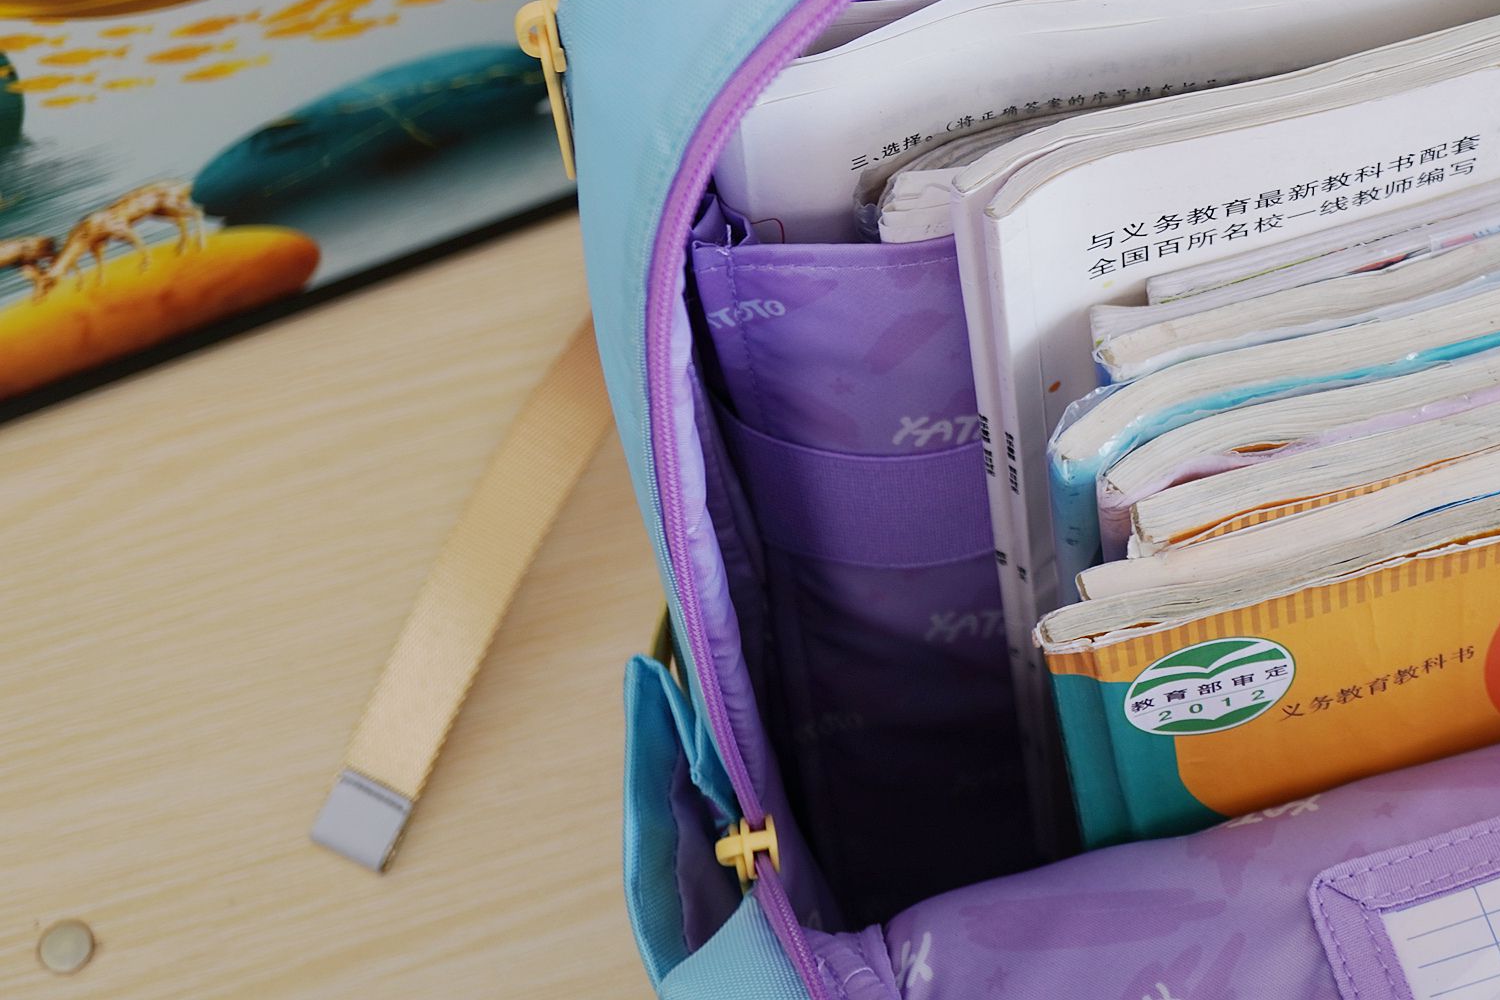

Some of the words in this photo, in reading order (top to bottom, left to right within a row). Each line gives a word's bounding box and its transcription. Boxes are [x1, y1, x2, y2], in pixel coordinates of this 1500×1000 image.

[1085, 133, 1481, 252] 与义务教育最新教科书配套
[1087, 157, 1478, 280] 全国百所名校一线教师编写
[1131, 664, 1289, 713] 教育部审定
[1158, 689, 1266, 722] 2012
[1276, 645, 1475, 722] 义务教育教科书
